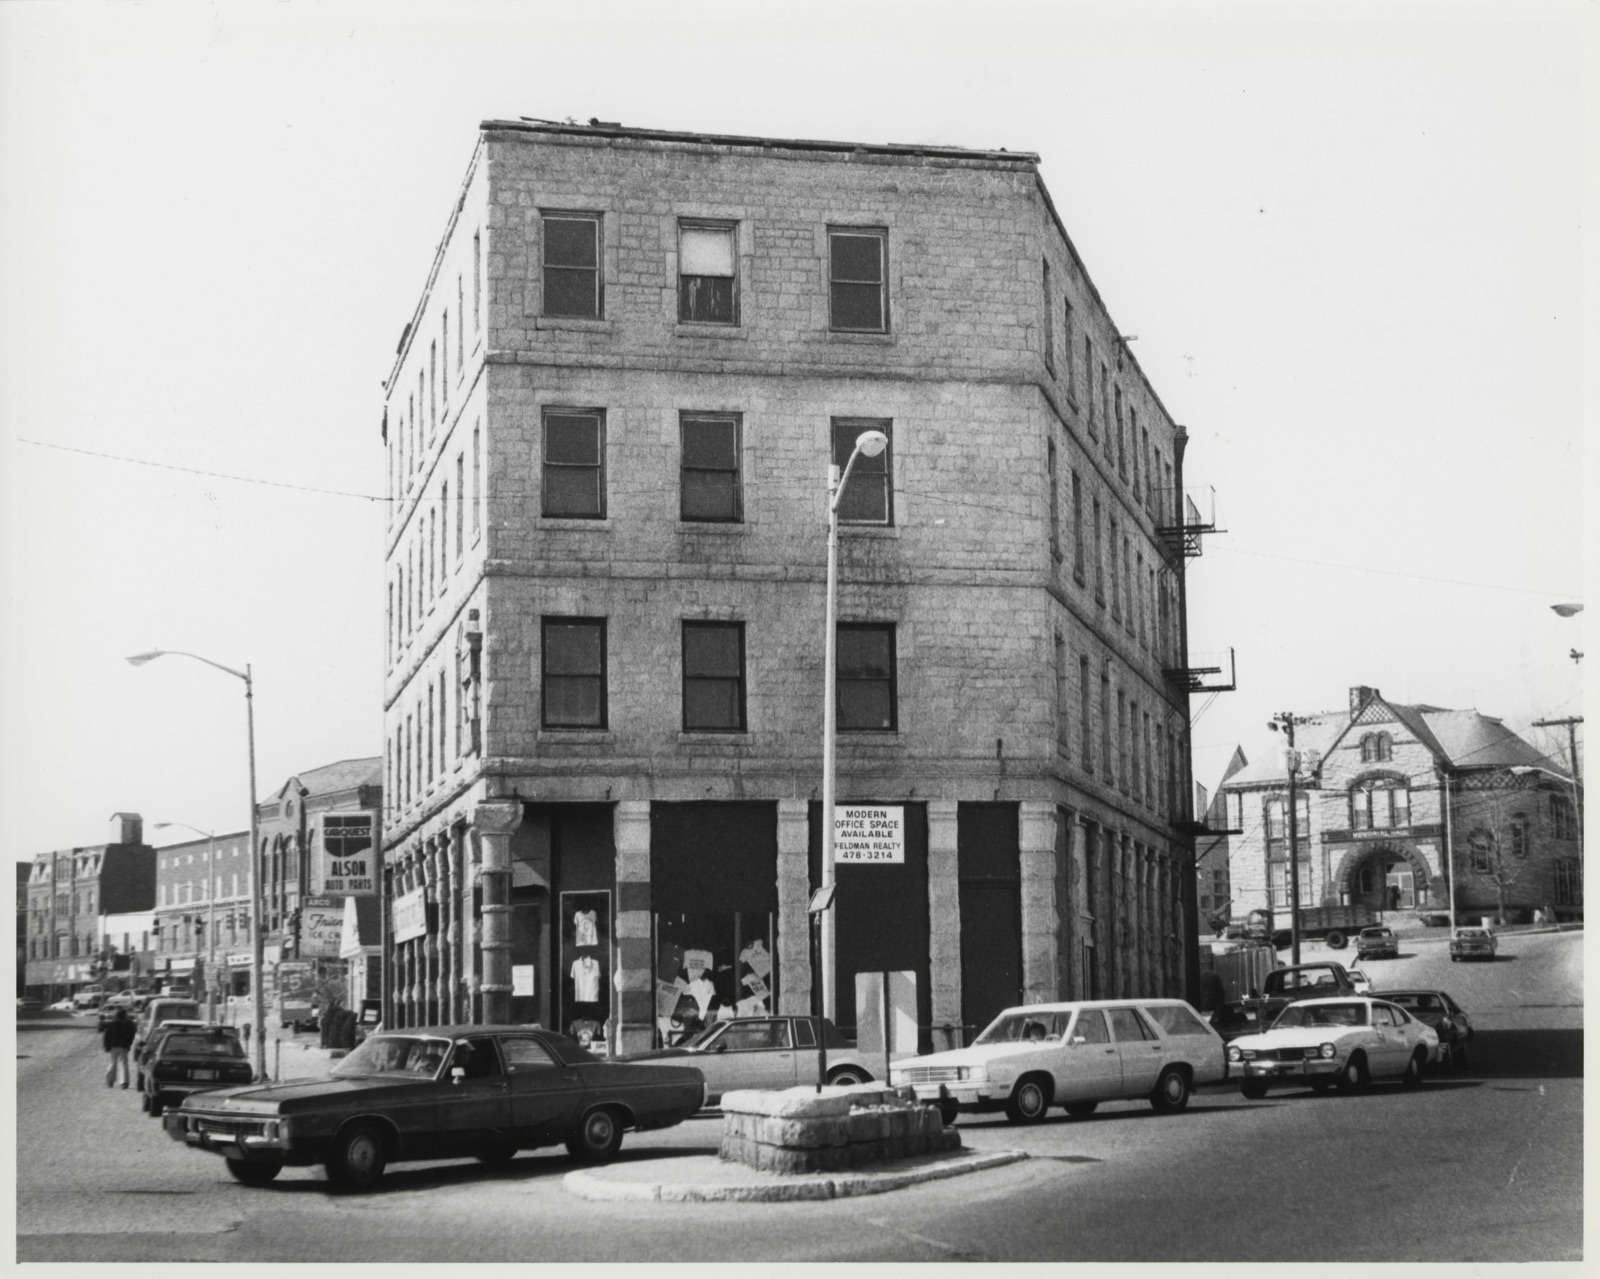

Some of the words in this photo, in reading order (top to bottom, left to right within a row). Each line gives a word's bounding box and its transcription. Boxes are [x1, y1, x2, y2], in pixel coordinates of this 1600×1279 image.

[846, 810, 887, 819] MODERN
[834, 820, 865, 829] OFFICE
[870, 820, 899, 829] SPACE
[324, 828, 371, 837] CARQUEST
[841, 830, 893, 838] AVAILABLE
[1353, 830, 1390, 839] MEMORIAL
[1391, 829, 1410, 837] HALL
[834, 842, 870, 850] FELDMAN
[873, 842, 901, 850] REALTY
[331, 860, 366, 877] ALSON
[325, 879, 344, 890] AUTO
[348, 878, 372, 890] PARTS
[308, 898, 331, 906] ARCO
